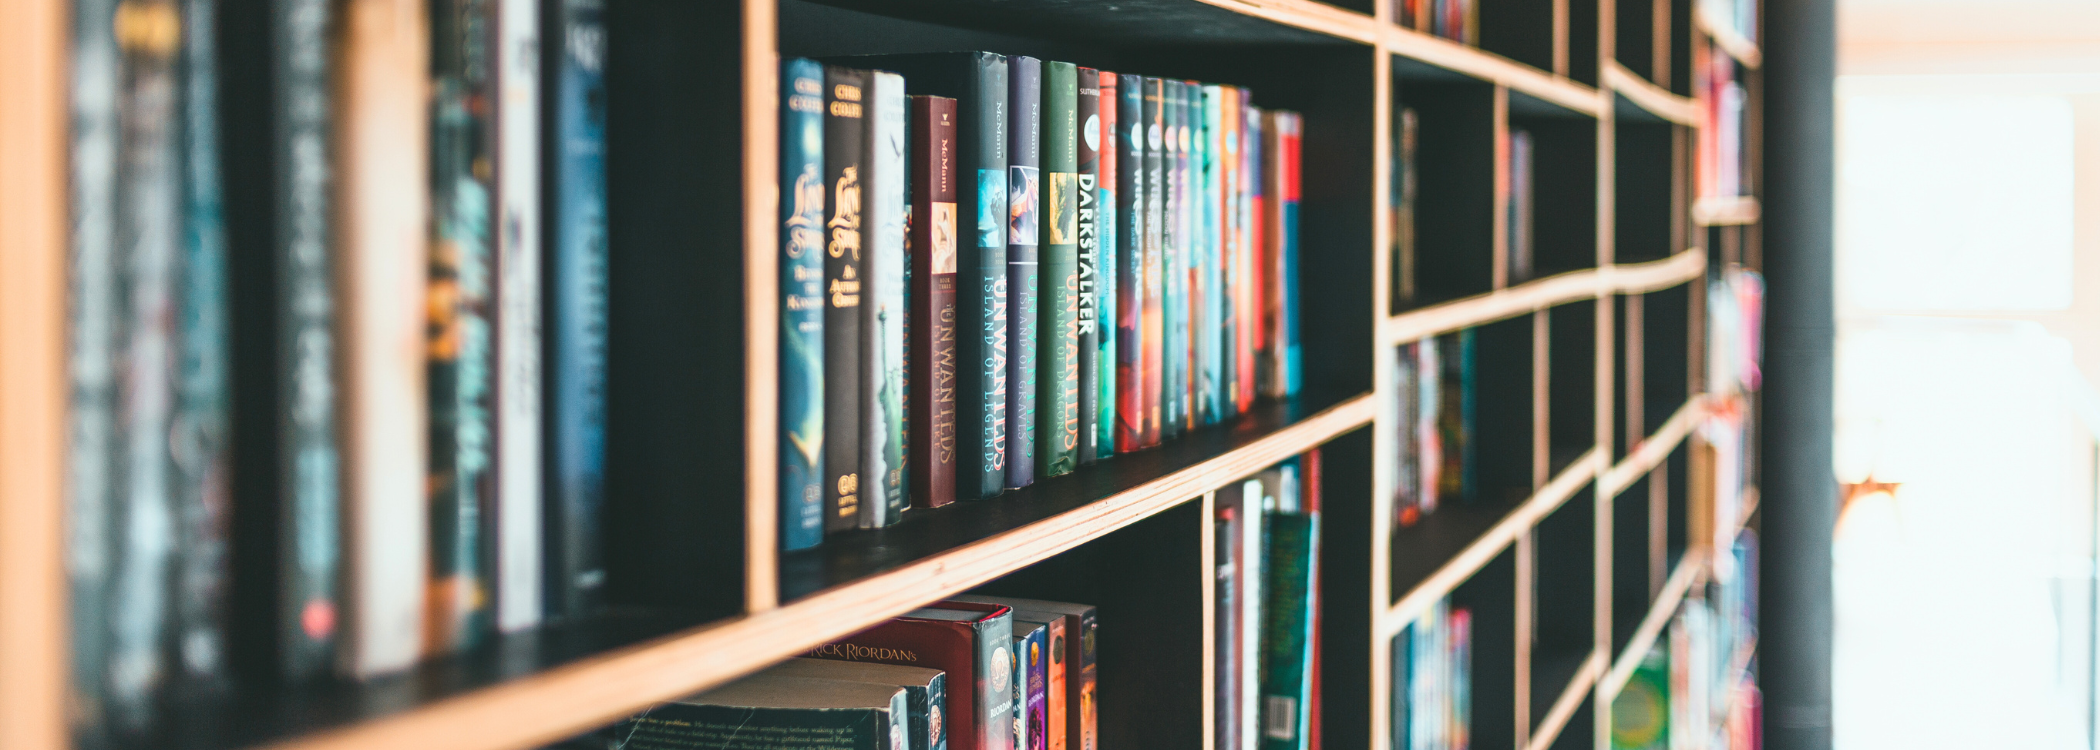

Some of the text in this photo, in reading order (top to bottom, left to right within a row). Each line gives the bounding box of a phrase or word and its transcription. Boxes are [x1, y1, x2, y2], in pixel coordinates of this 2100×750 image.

[941, 139, 949, 193] McMann
[1078, 173, 1095, 335] DARKSTALKER
[933, 325, 941, 450] ISLAND OF FIRE
[940, 303, 956, 464] UNWANTEDS
[984, 276, 994, 473] ISLAND OF LEGENDS
[993, 279, 1007, 471] UNWANTEDS
[1017, 292, 1028, 440] ISLAND OF GRAVES
[1056, 285, 1066, 439] ISLAND OF DRAGONS
[1064, 273, 1079, 451] UNWANTEDS
[990, 698, 1012, 719] RIORDAN
